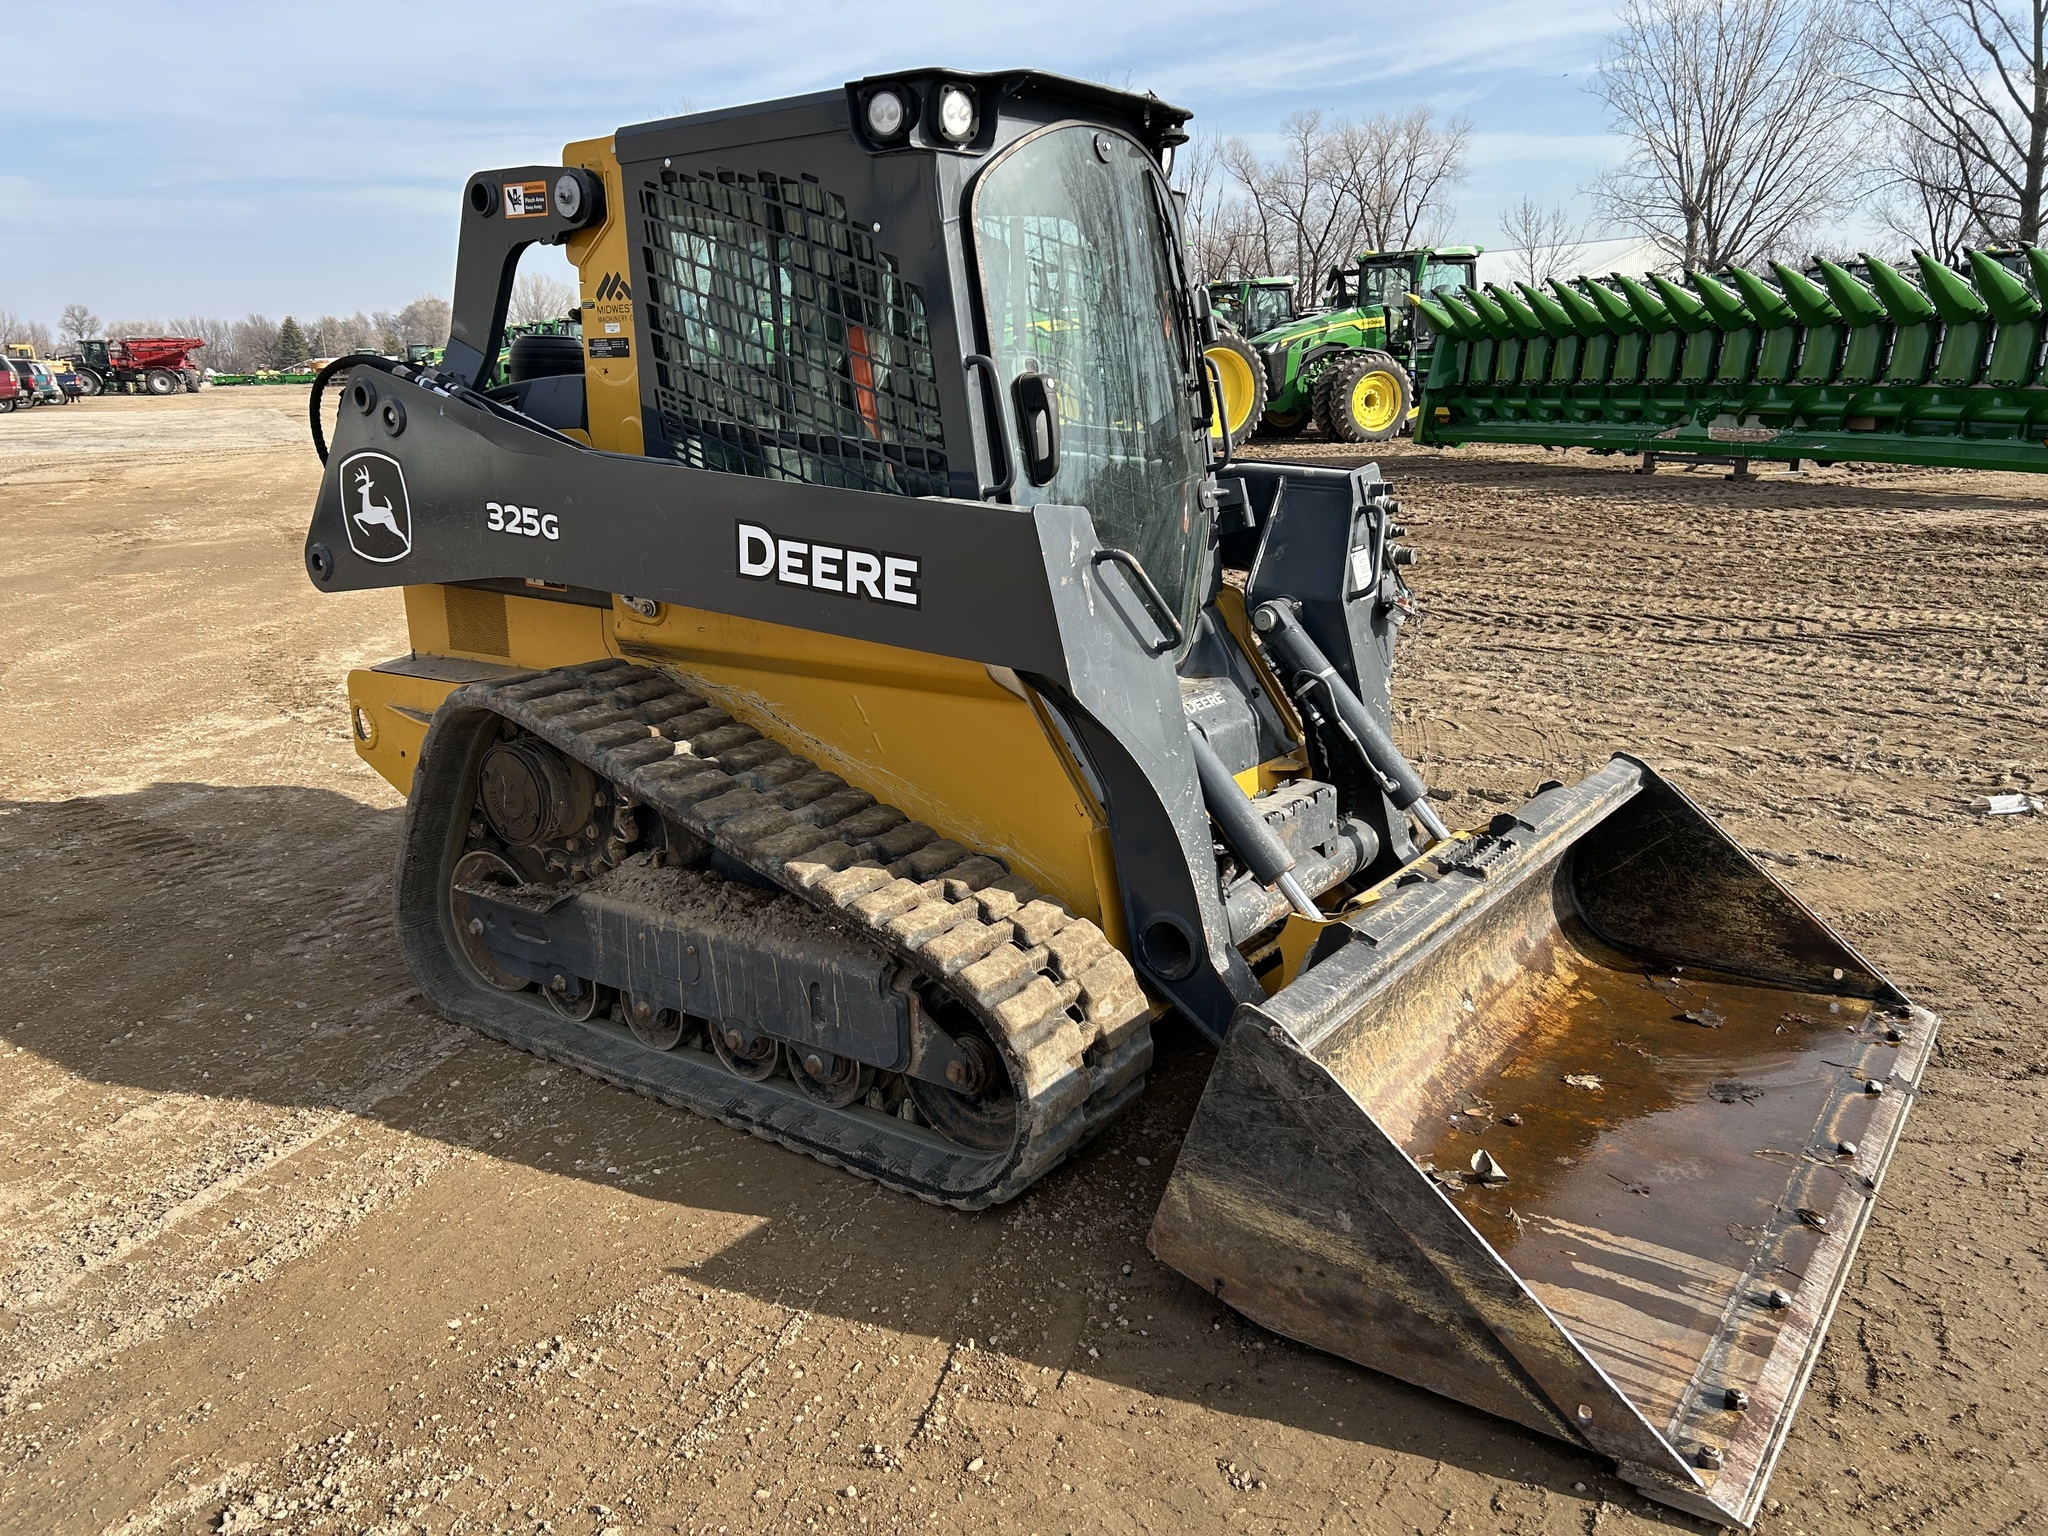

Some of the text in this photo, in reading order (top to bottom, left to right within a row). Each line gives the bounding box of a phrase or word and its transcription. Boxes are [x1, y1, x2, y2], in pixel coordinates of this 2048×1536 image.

[597, 315, 628, 323] MACHINERY
[486, 502, 559, 540] 325G
[738, 523, 918, 605] DEERE
[1184, 691, 1226, 714] DEERE
